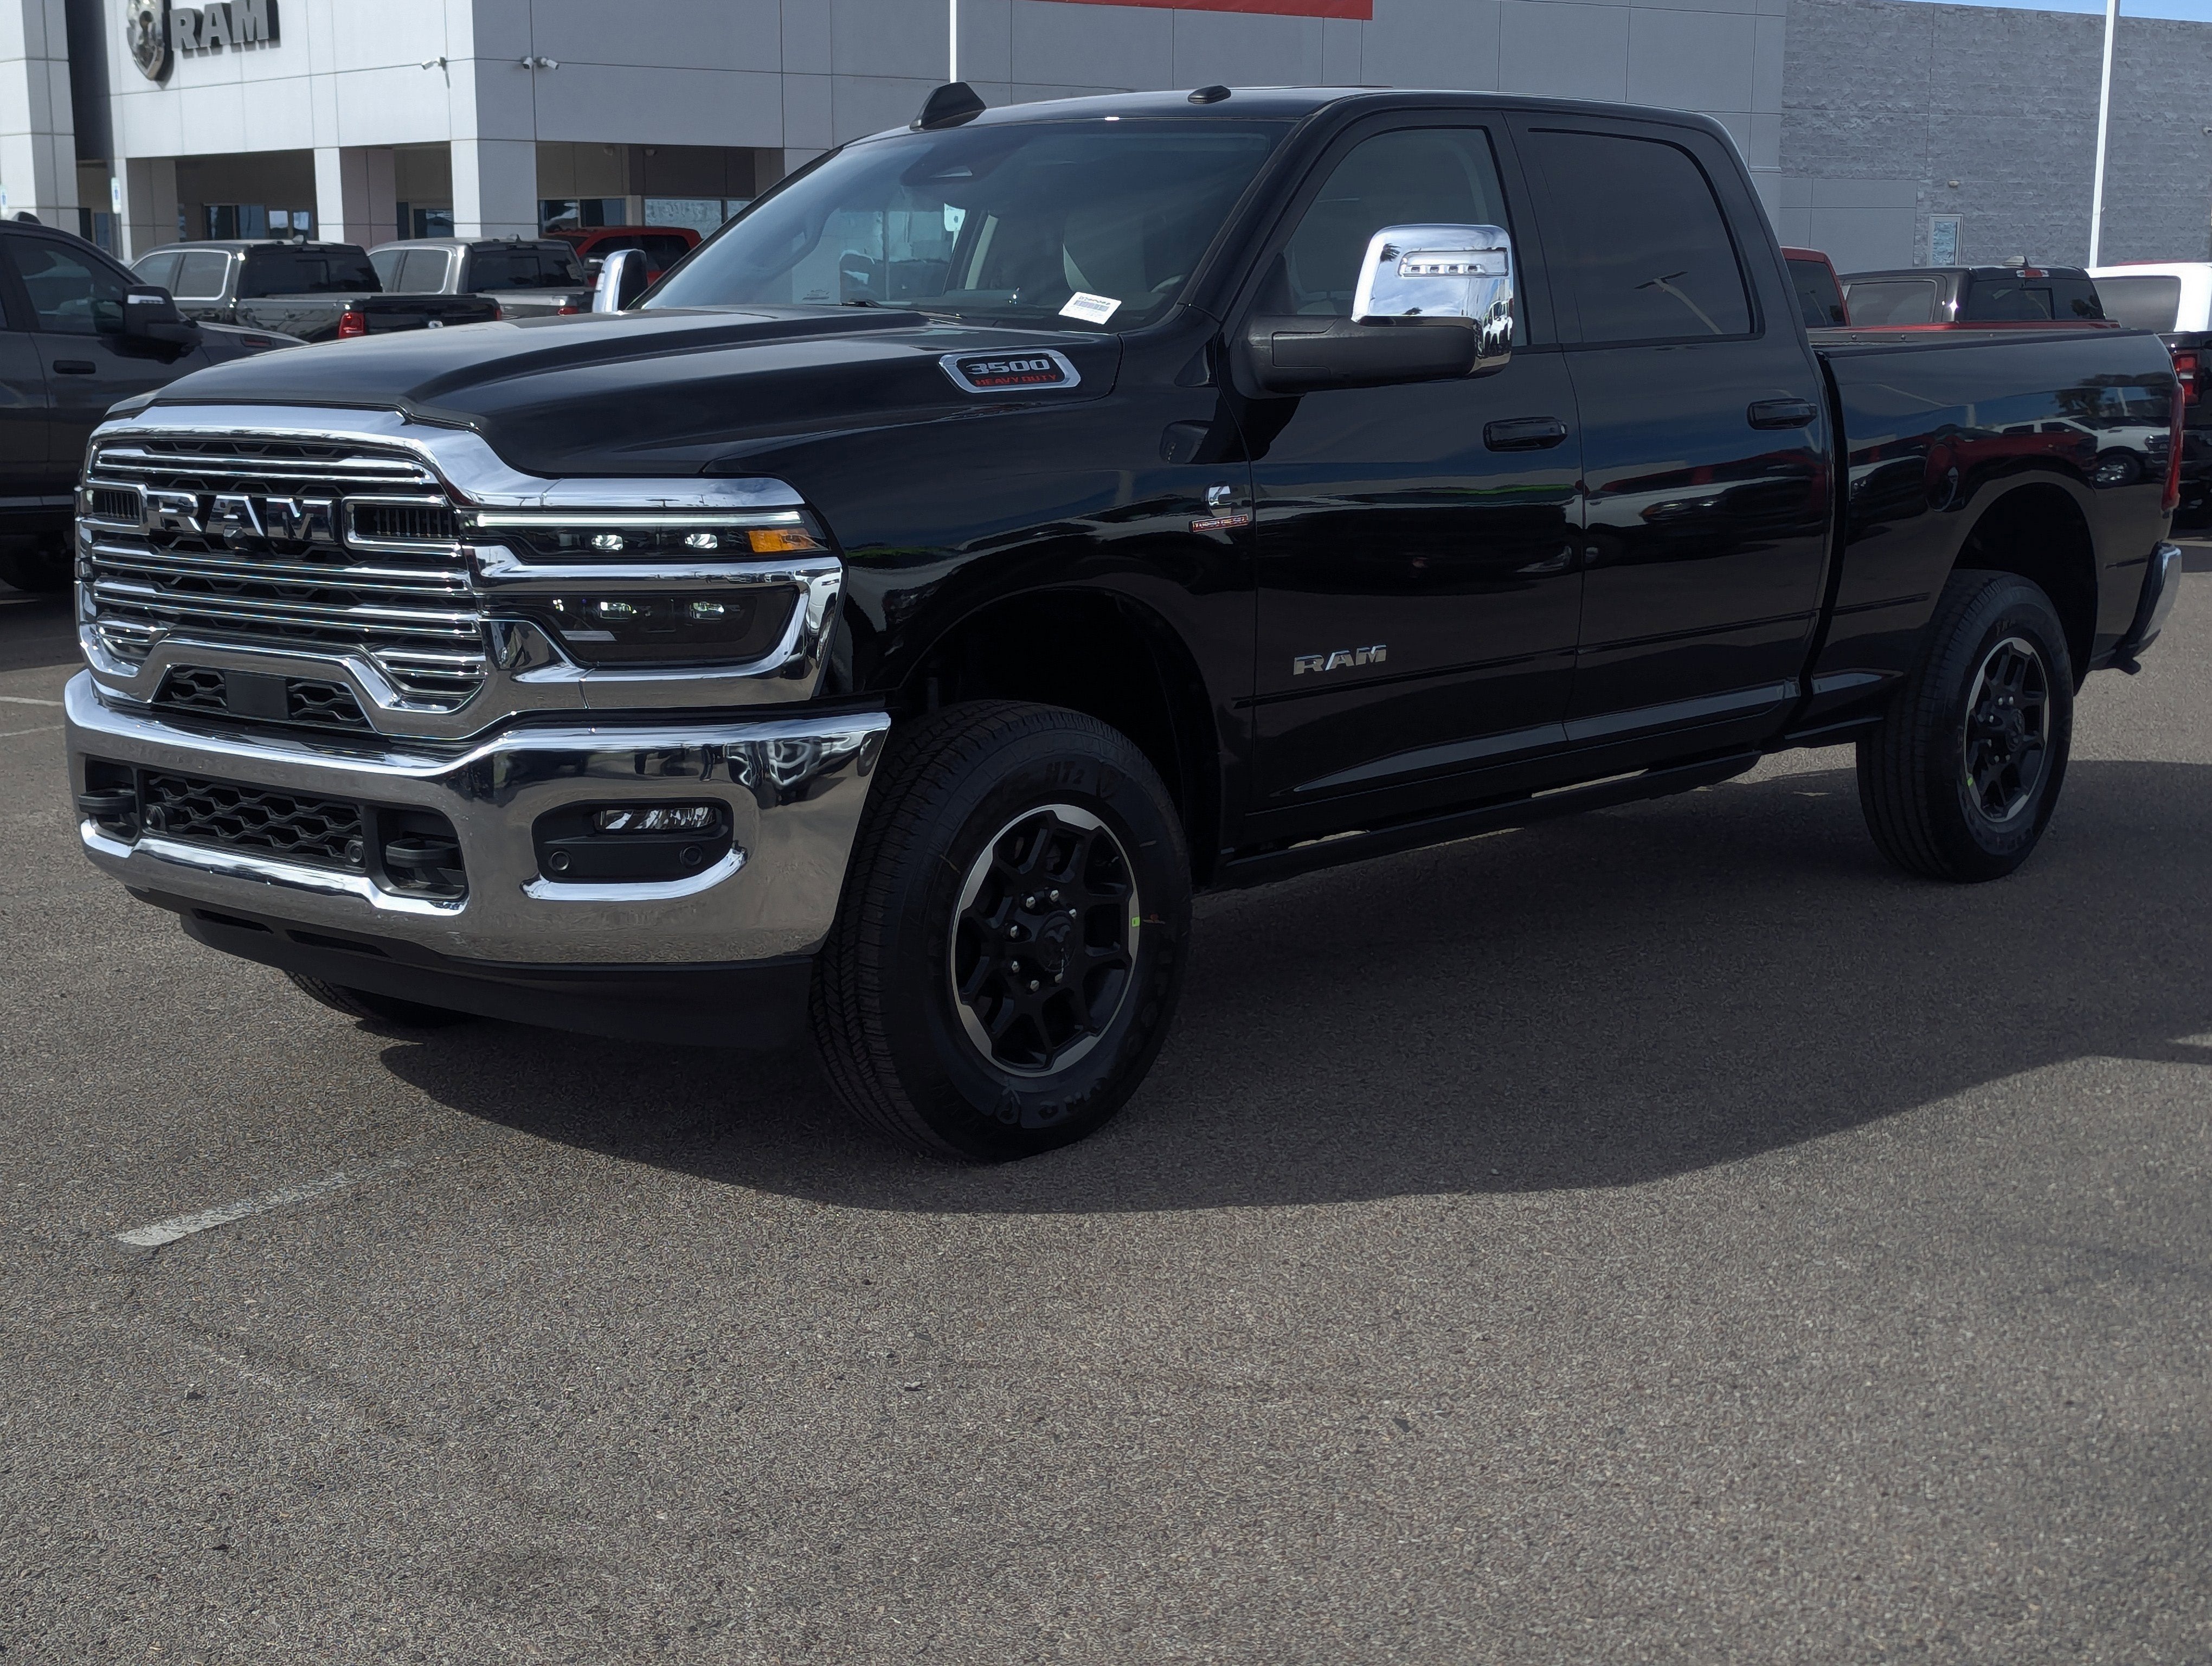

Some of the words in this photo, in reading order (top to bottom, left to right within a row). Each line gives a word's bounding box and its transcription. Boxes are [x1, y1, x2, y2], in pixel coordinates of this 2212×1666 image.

[170, 0, 276, 49] RAM
[966, 359, 1051, 375] 3500
[975, 376, 1019, 387] HEAVY
[1021, 373, 1057, 383] DUTY
[144, 490, 336, 542] RAM
[1293, 644, 1387, 676] RAM
